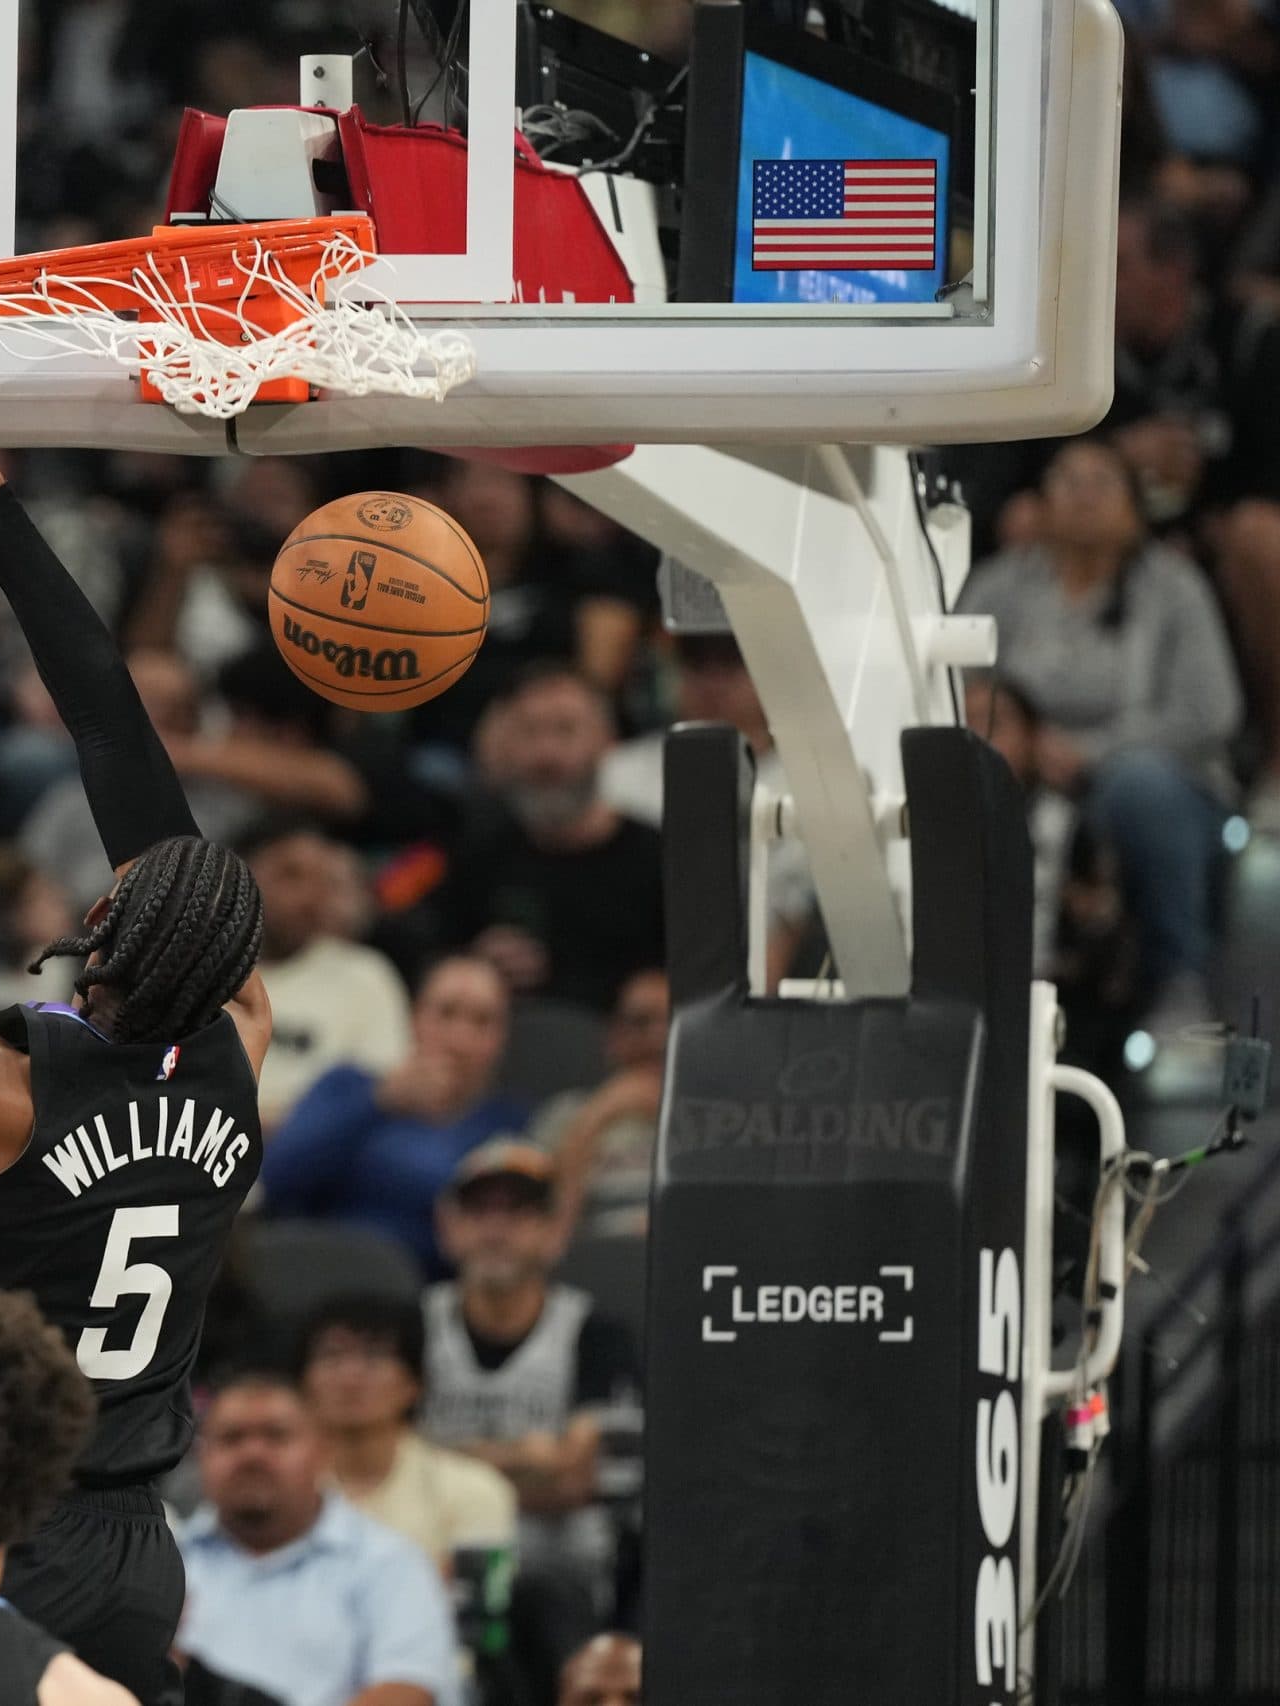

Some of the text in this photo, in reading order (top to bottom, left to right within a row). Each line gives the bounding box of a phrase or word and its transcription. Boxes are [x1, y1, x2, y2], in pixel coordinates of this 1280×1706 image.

[283, 612, 422, 681] Wilson
[42, 1096, 250, 1198] WILLIAMS
[669, 1096, 950, 1156] SPALDING
[76, 1205, 179, 1380] 5
[732, 1286, 884, 1322] LEDGER
